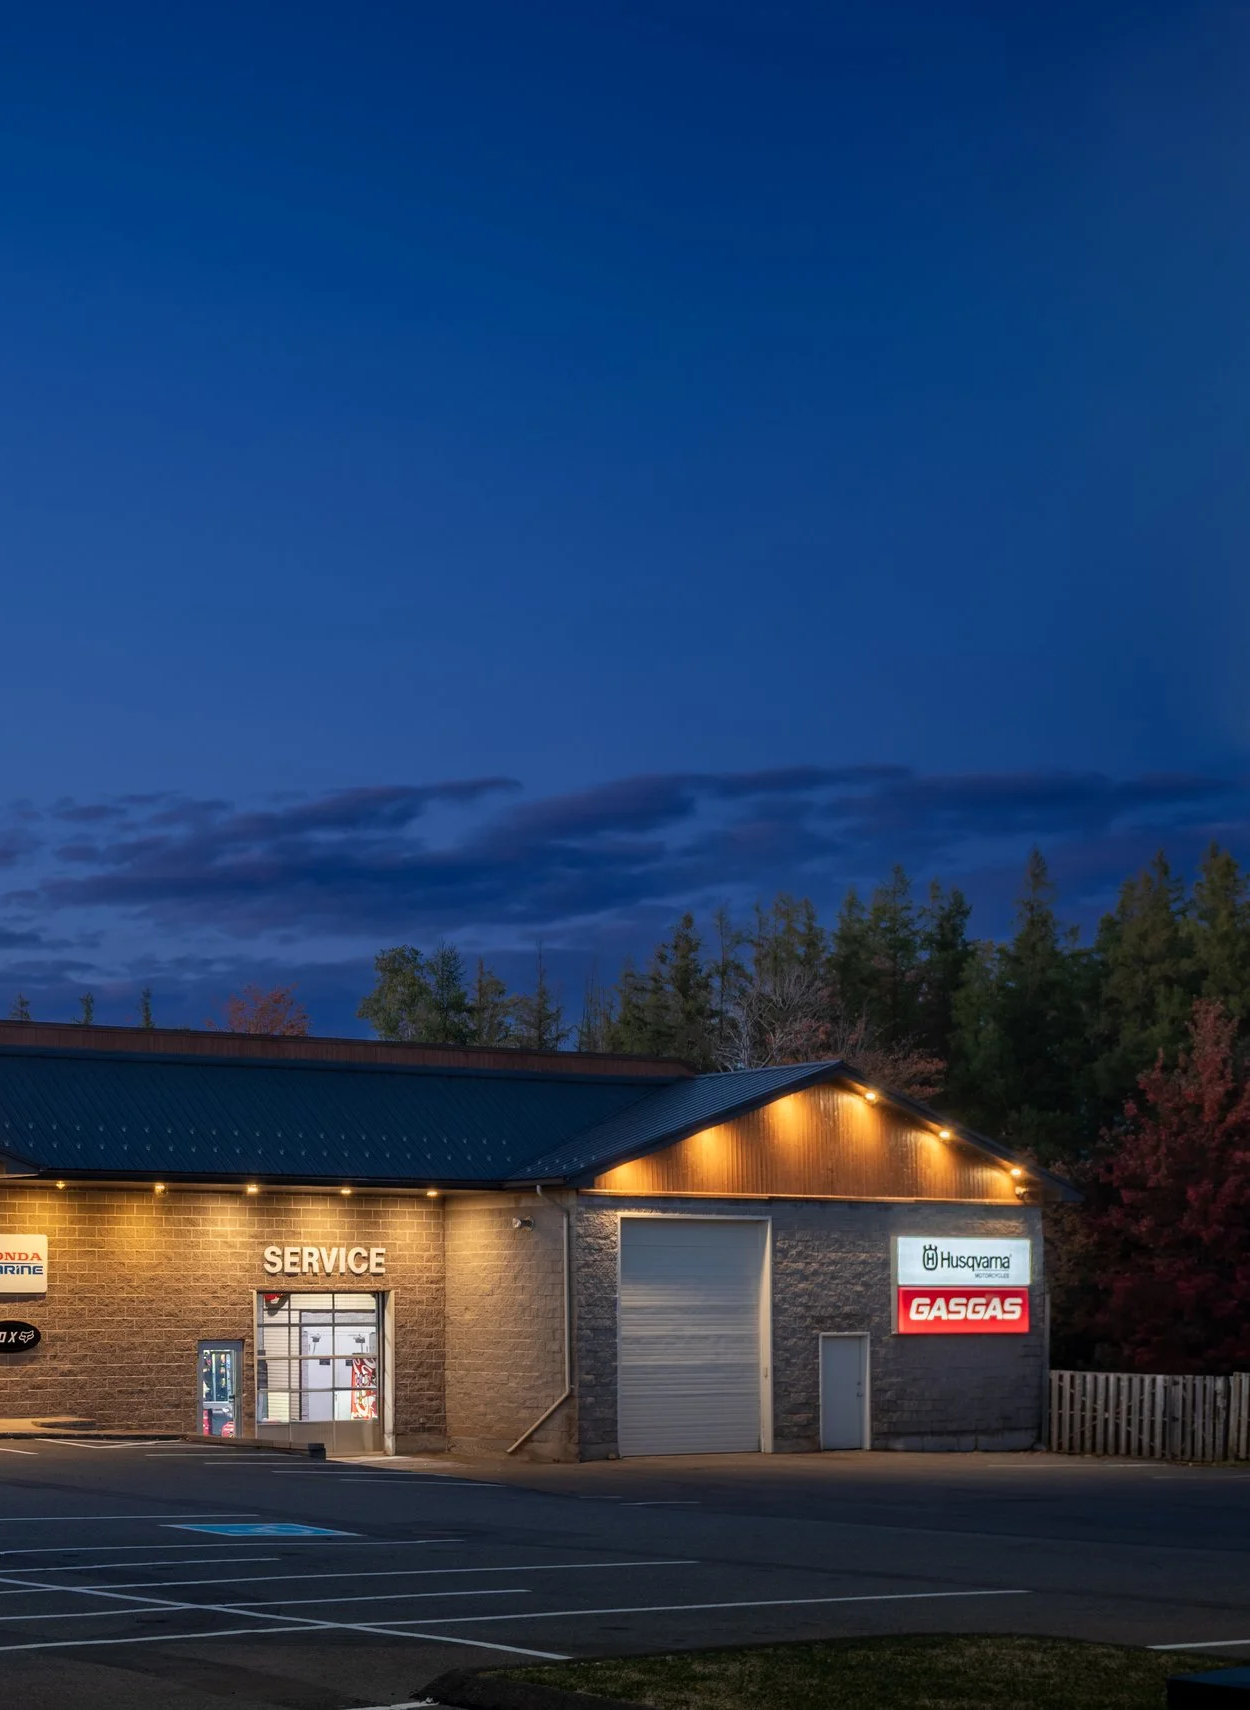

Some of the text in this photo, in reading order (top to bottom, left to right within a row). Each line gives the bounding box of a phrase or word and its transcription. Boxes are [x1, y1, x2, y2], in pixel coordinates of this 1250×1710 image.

[263, 1245, 387, 1275] SERVICE
[940, 1252, 1010, 1271] Husqvarna
[909, 1297, 1023, 1321] GASGAS
